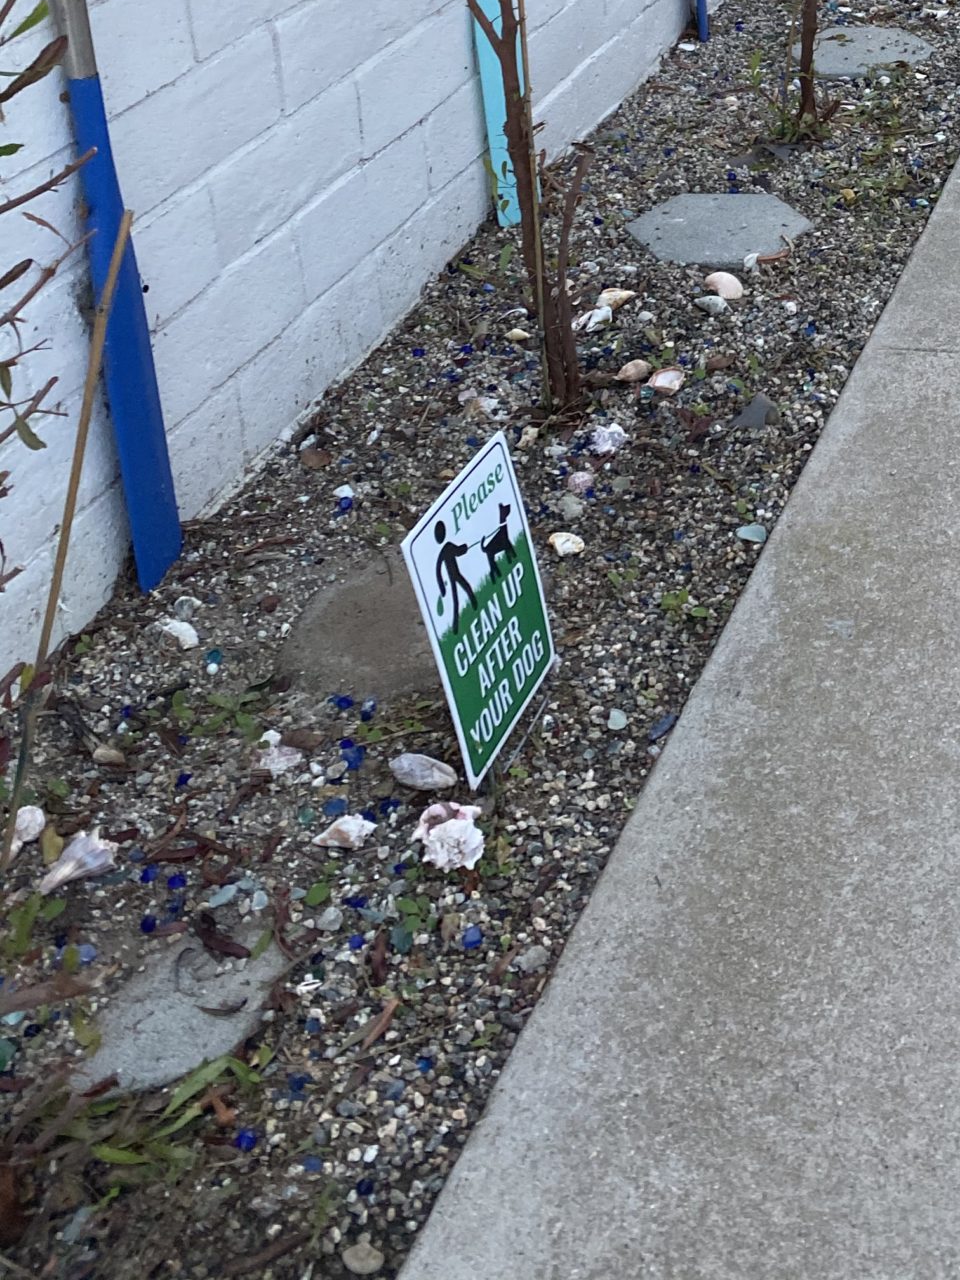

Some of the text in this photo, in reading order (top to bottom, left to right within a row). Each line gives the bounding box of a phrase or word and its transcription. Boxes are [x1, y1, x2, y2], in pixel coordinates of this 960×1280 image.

[450, 463, 504, 534] Please
[454, 562, 524, 677] CLEAN UP
[478, 616, 523, 697] AFTER
[470, 630, 544, 754] YOUR DOG
